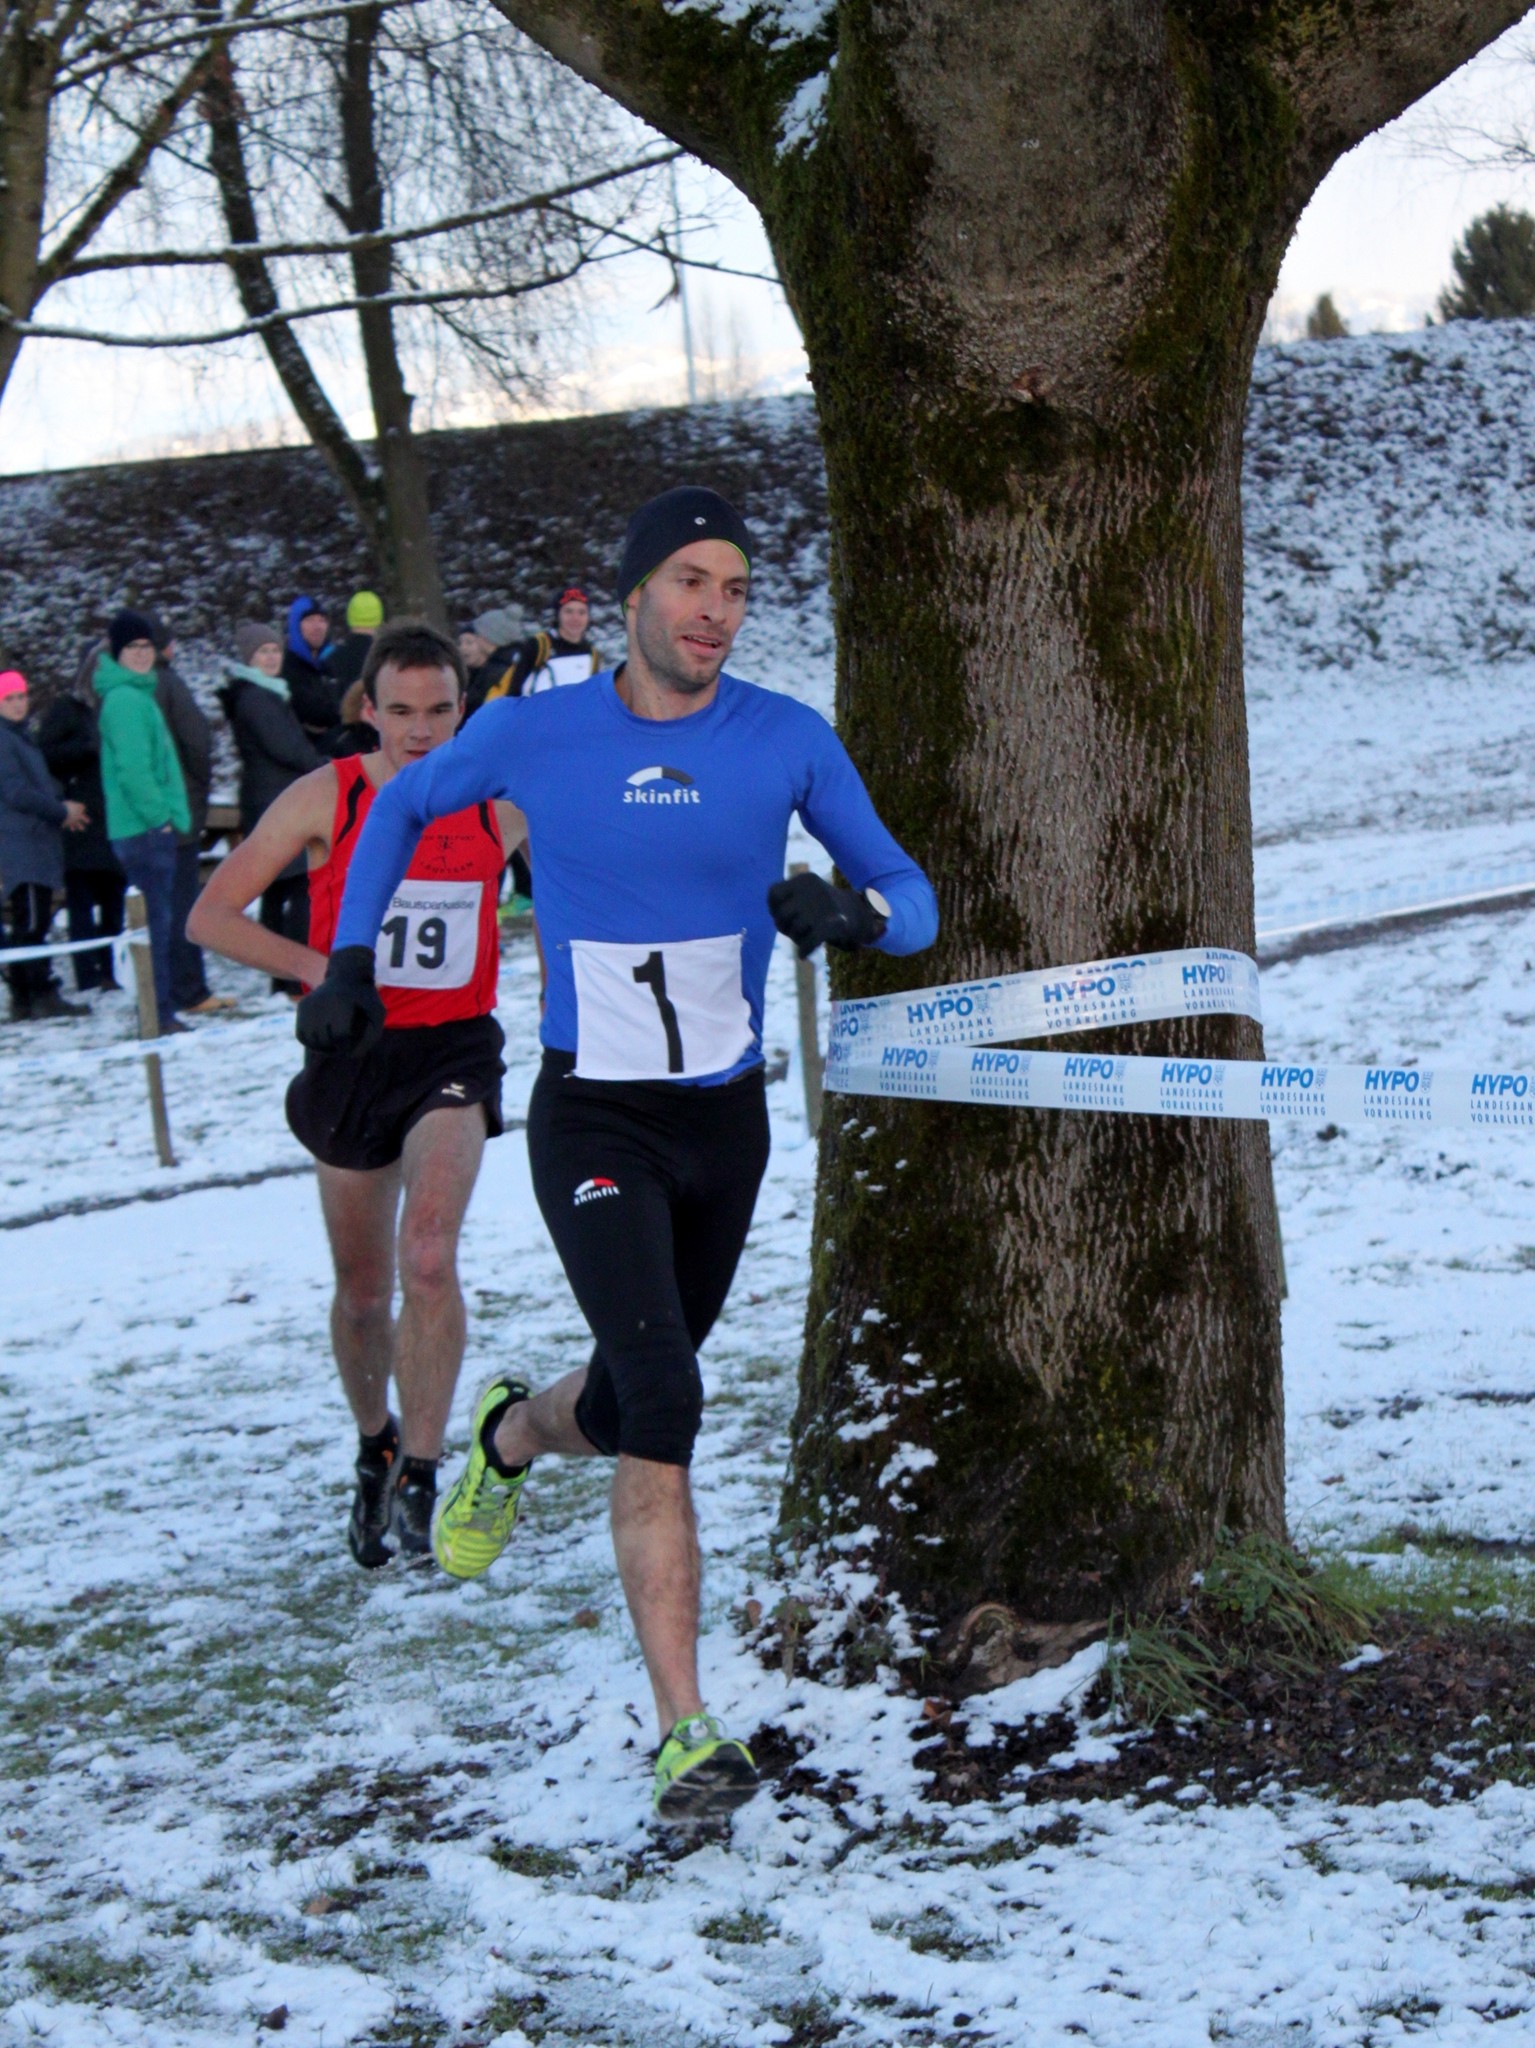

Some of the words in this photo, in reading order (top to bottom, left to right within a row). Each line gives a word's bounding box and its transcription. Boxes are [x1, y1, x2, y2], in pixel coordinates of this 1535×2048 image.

[623, 788, 700, 804] skinfit
[391, 897, 475, 911] Bausparkasse
[380, 915, 447, 970] 19
[1182, 963, 1226, 985] HYPO
[1042, 976, 1116, 1004] HYPO
[632, 951, 684, 1073] 1
[907, 997, 974, 1024] HYPO
[1045, 996, 1135, 1017] LANDESBANK
[1046, 1008, 1137, 1029] VORARLBERG
[909, 1016, 993, 1038] LANDESBANK
[882, 1046, 928, 1069] HYPO
[971, 1052, 1019, 1074] HYPO
[879, 1070, 937, 1082] LANDESBANK
[1064, 1057, 1114, 1080] HYPO
[1161, 1062, 1213, 1085] HYPO
[970, 1076, 1029, 1088] LANDESBANK
[1261, 1067, 1314, 1089] HYPO
[1364, 1070, 1420, 1093] HYPO
[1471, 1074, 1528, 1097] HYPO
[879, 1082, 937, 1095] VORARLBERG
[971, 1088, 1029, 1100] VORARLBERG
[1063, 1081, 1124, 1094] LANDESBANK
[1160, 1087, 1223, 1099] LANDESBANK
[1063, 1093, 1124, 1107] VORARLBERG
[1260, 1091, 1325, 1102] LANDESBANK
[1363, 1095, 1431, 1107] LANDESBANK
[1160, 1100, 1224, 1112] VORARLBERG
[1260, 1104, 1326, 1116] VORARLBERG
[1470, 1099, 1535, 1111] LANDESBAN
[1364, 1108, 1432, 1121] VORARLBERG
[1470, 1113, 1535, 1125] VORARLBER
